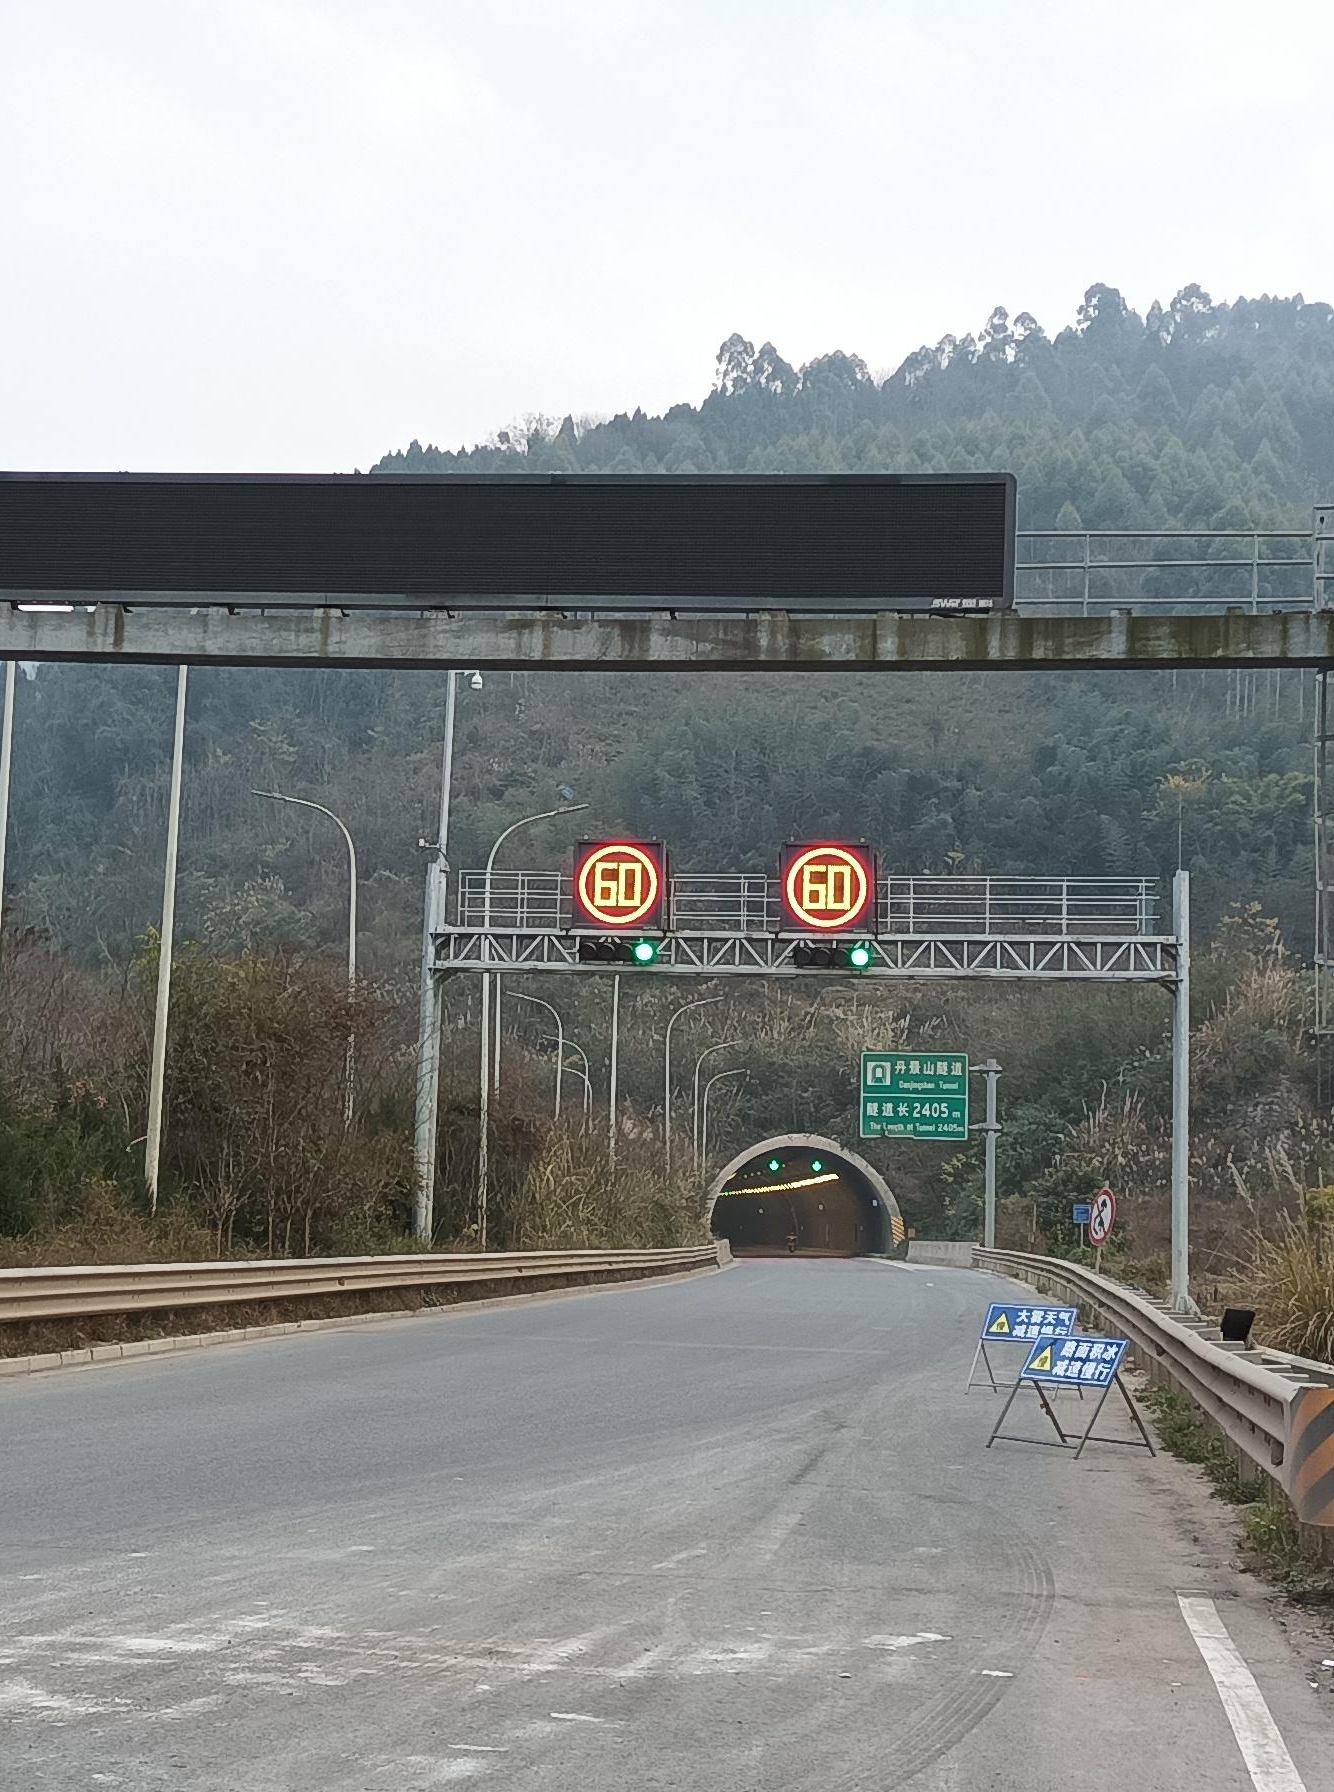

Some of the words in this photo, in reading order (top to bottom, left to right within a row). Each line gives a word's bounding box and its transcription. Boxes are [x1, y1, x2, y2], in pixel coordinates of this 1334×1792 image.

[594, 862, 642, 907] 60
[803, 865, 851, 910] 60
[894, 1060, 963, 1076] 丹景山隧道
[939, 1081, 959, 1090] Tunnel
[870, 1122, 881, 1130] The
[906, 1123, 914, 1131] of
[915, 1123, 936, 1132] Tunnel
[1016, 1309, 1072, 1326] 大雾天气
[1060, 1340, 1119, 1361] 路面积冰
[1052, 1360, 1112, 1381] 减速慢行
